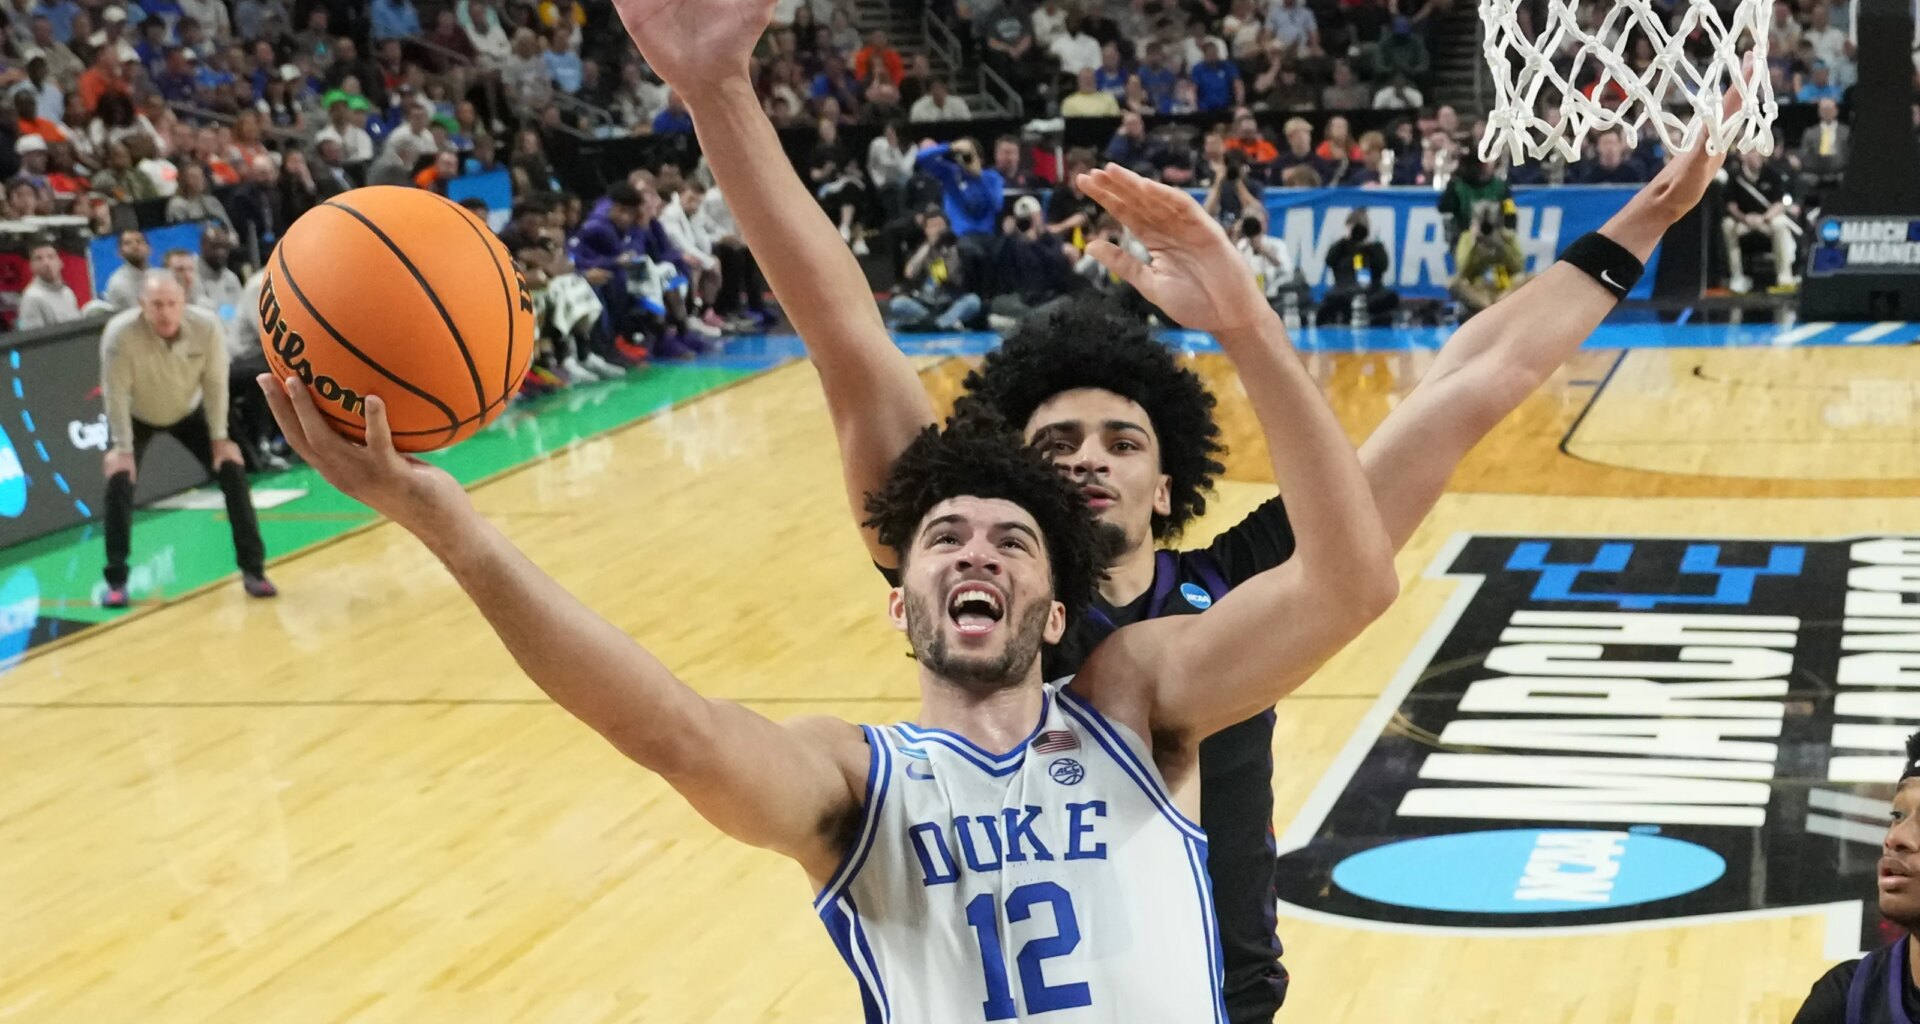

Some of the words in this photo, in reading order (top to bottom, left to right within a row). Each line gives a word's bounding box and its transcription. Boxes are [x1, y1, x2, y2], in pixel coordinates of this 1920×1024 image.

[1279, 206, 1563, 287] MARH
[1840, 221, 1909, 242] MARCH
[259, 269, 366, 416] Wilson
[1396, 610, 1801, 828] MARCH
[908, 800, 1107, 887] DUKE
[1513, 831, 1630, 904] NCAA
[966, 881, 1092, 1022] 12
